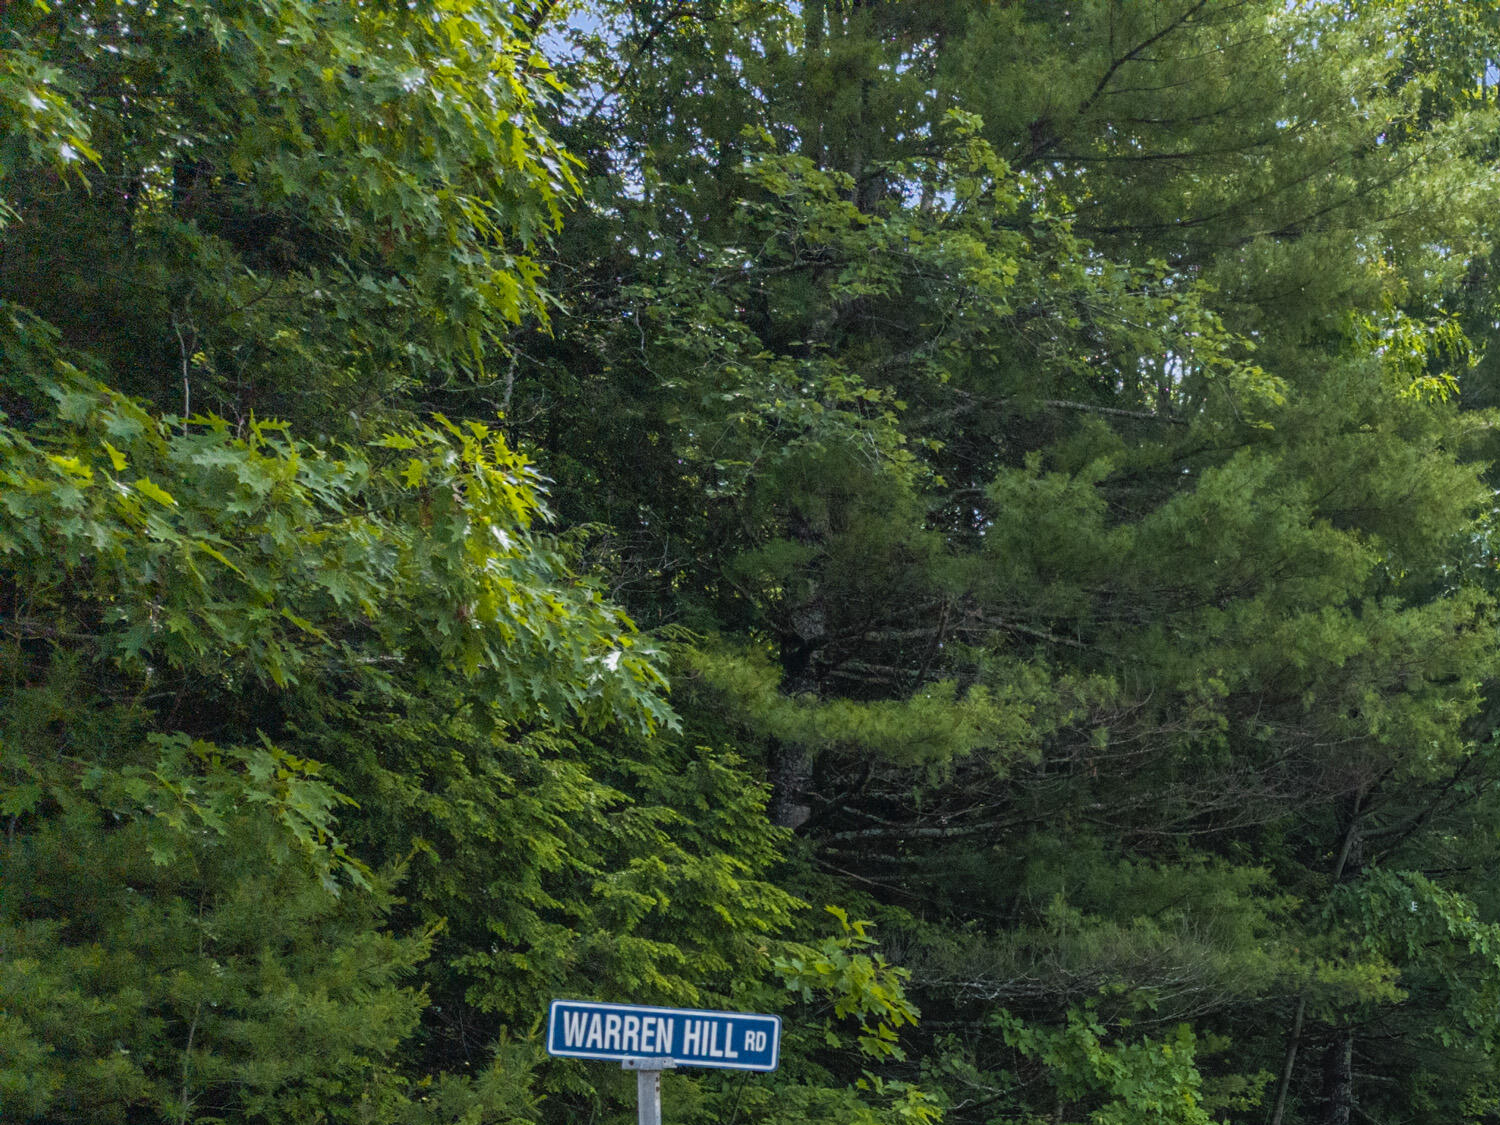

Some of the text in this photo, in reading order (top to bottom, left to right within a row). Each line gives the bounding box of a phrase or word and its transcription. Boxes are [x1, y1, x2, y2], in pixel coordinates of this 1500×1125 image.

[563, 1010, 767, 1058] WARREN HILL RD
